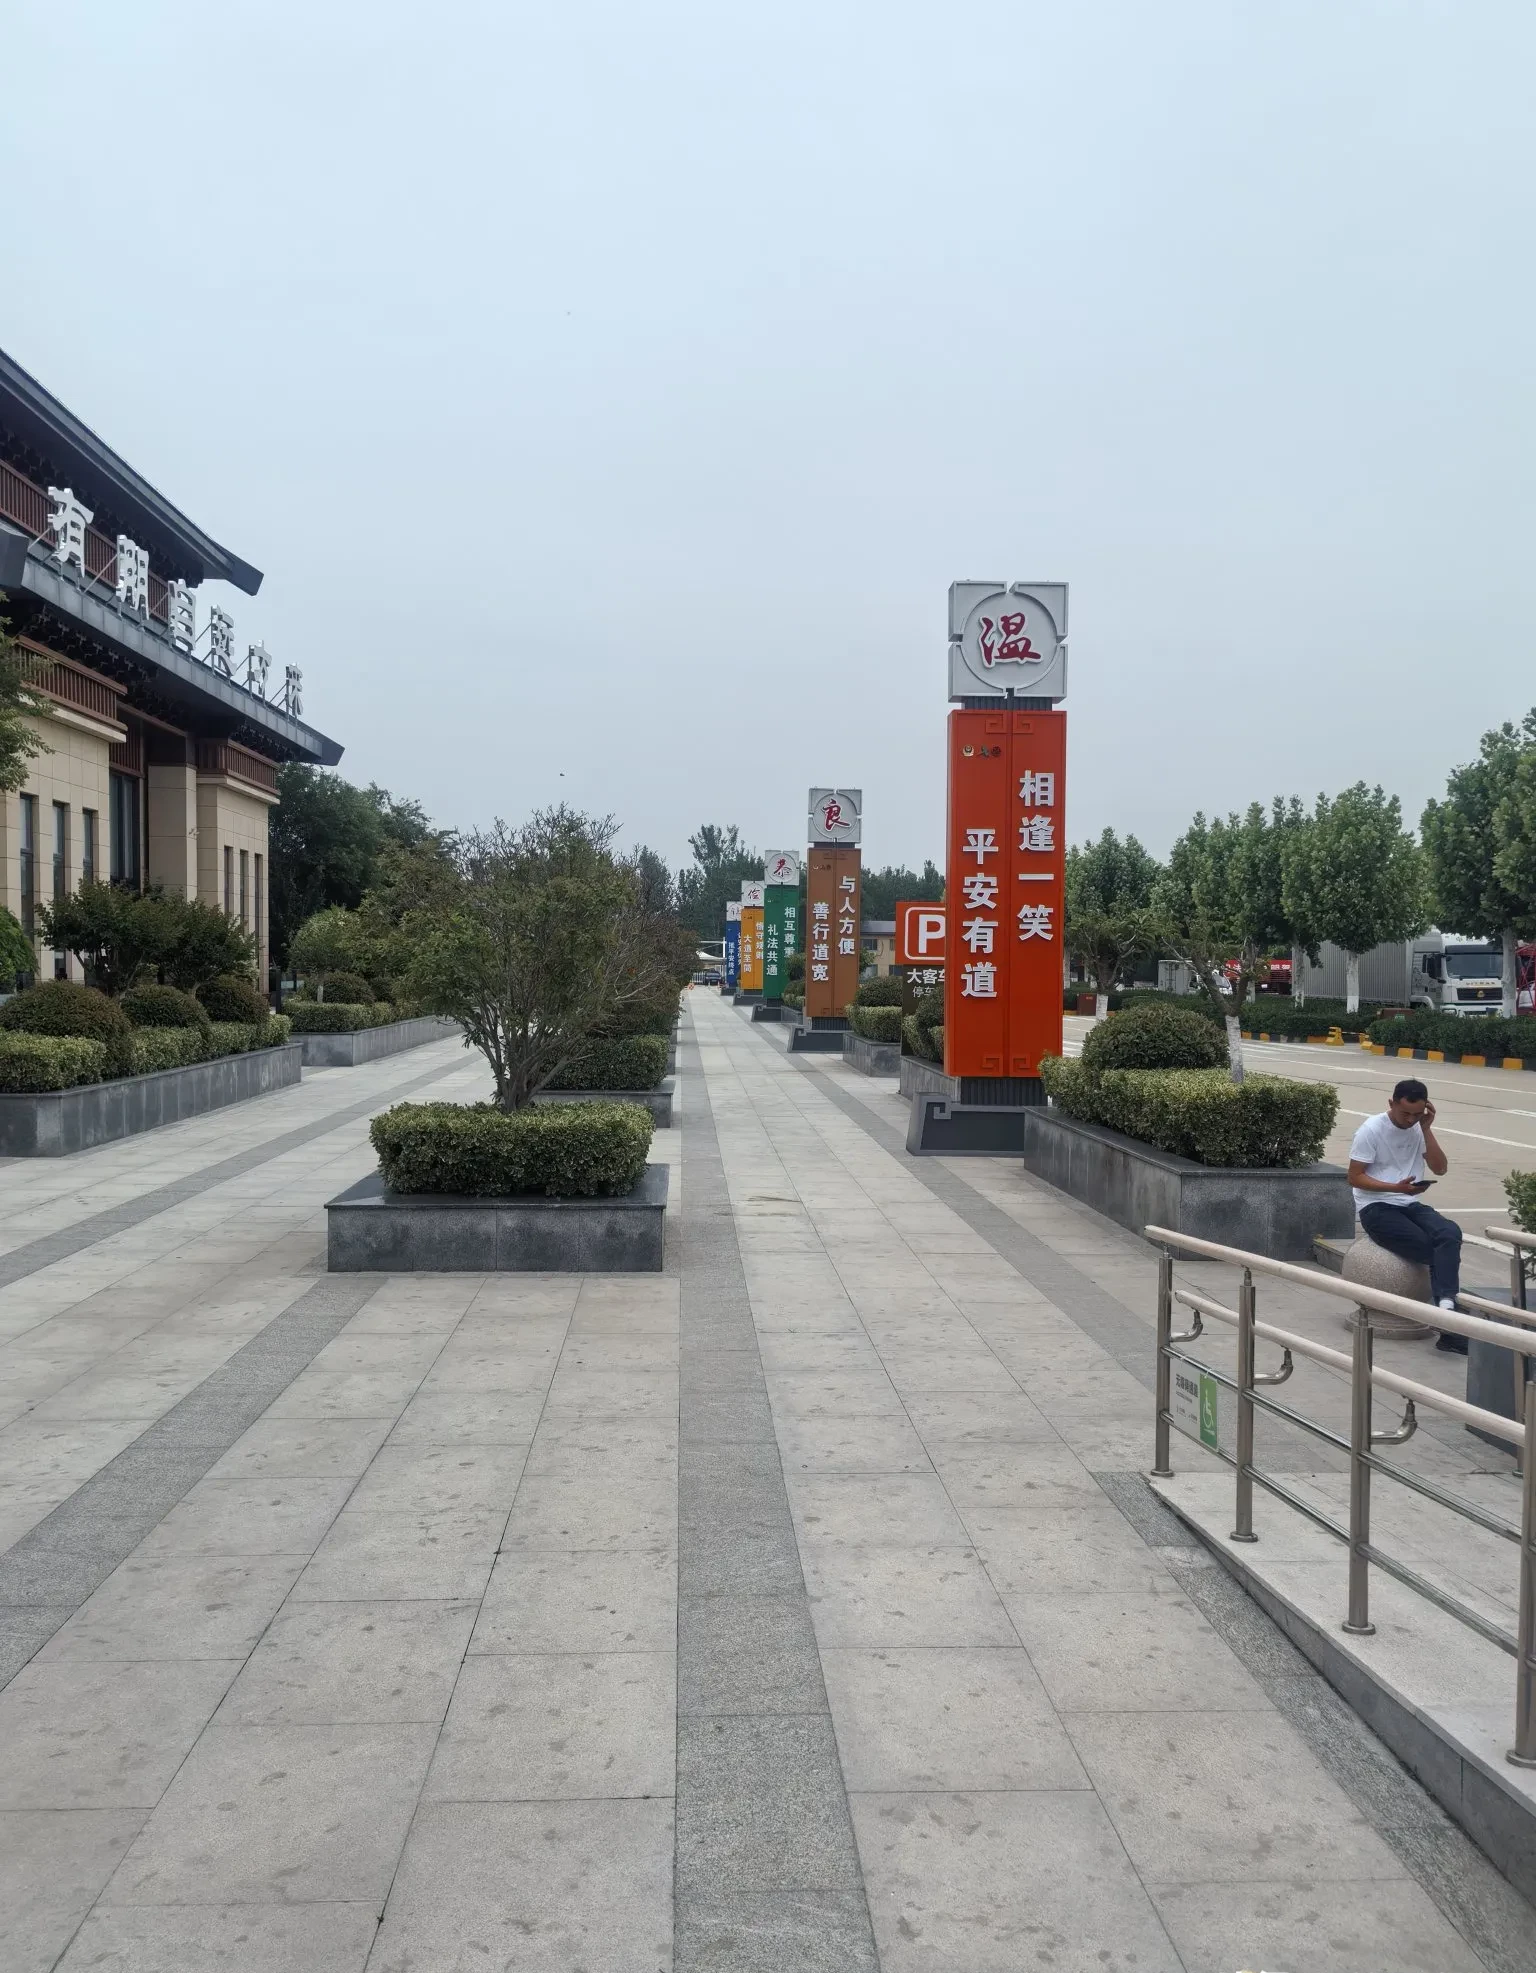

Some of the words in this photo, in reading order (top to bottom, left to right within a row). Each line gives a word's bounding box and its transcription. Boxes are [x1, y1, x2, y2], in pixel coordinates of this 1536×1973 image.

[978, 611, 1041, 666] 温
[822, 798, 851, 832] 良
[1018, 769, 1055, 943] 相逢一笑
[783, 906, 796, 959] 相互尊重
[838, 876, 856, 956] 与人方便
[918, 914, 946, 954] P
[962, 828, 999, 998] 平安有道
[766, 924, 779, 977] 礼法共通
[812, 901, 830, 982] 善行道宽
